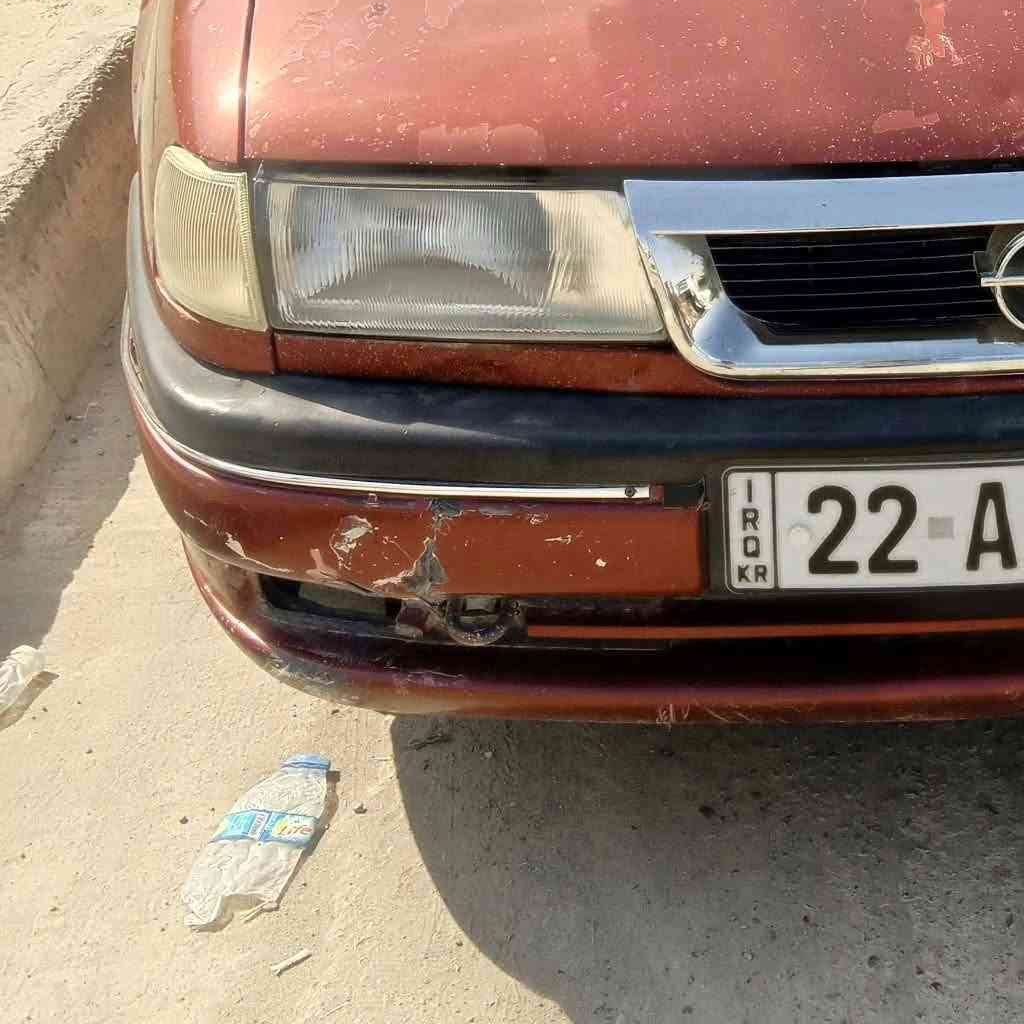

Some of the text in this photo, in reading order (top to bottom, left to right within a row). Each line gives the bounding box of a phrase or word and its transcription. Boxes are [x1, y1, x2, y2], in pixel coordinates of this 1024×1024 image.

[806, 484, 920, 576] 22
[965, 481, 1018, 572] A
[737, 564, 768, 583] KR
